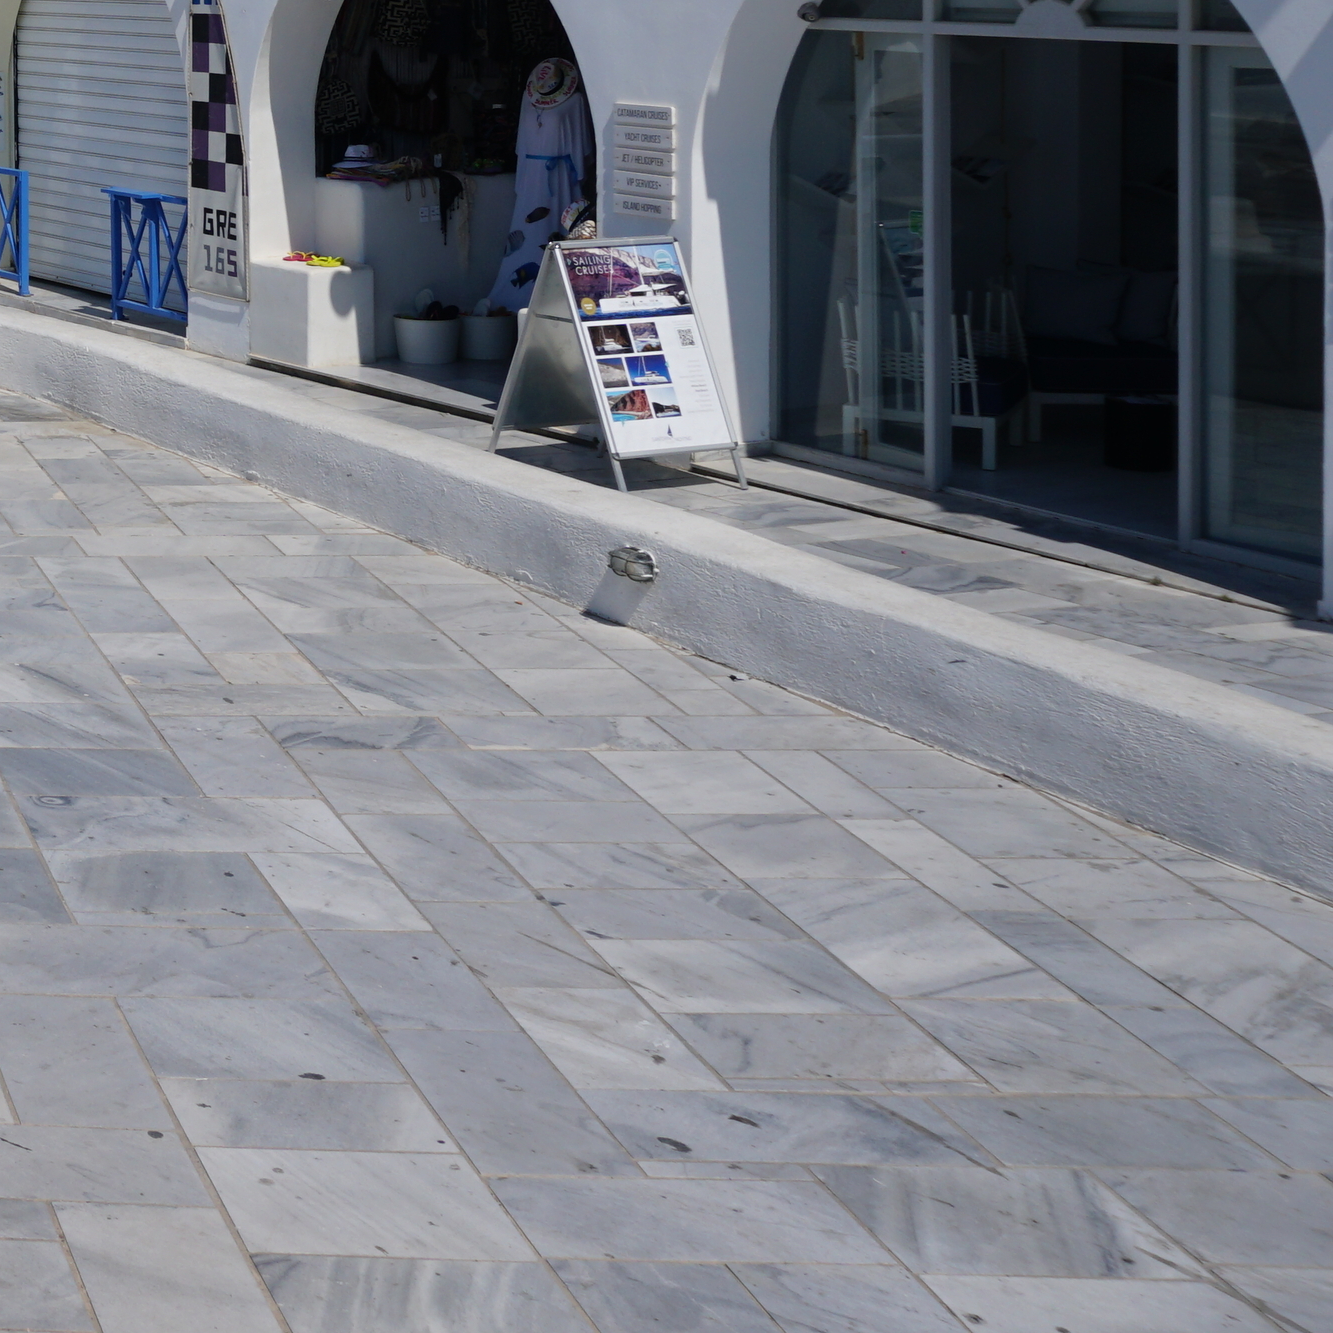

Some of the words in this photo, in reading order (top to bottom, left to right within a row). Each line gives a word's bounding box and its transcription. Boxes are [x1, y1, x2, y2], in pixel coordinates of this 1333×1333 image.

[617, 108, 647, 119] CATAMARAN
[648, 112, 668, 121] CRUISES
[625, 132, 640, 142] YACHT
[641, 134, 661, 144] CRUISES
[635, 155, 664, 167] HELICOPTER
[626, 177, 634, 186] VIP
[635, 178, 659, 190] SERVICES
[623, 201, 640, 211] ISLAND
[641, 204, 662, 215] HOPPING
[203, 207, 237, 241] GRE
[203, 244, 238, 278] 165
[573, 256, 611, 266] SAILING
[575, 265, 613, 276] CRUISES
